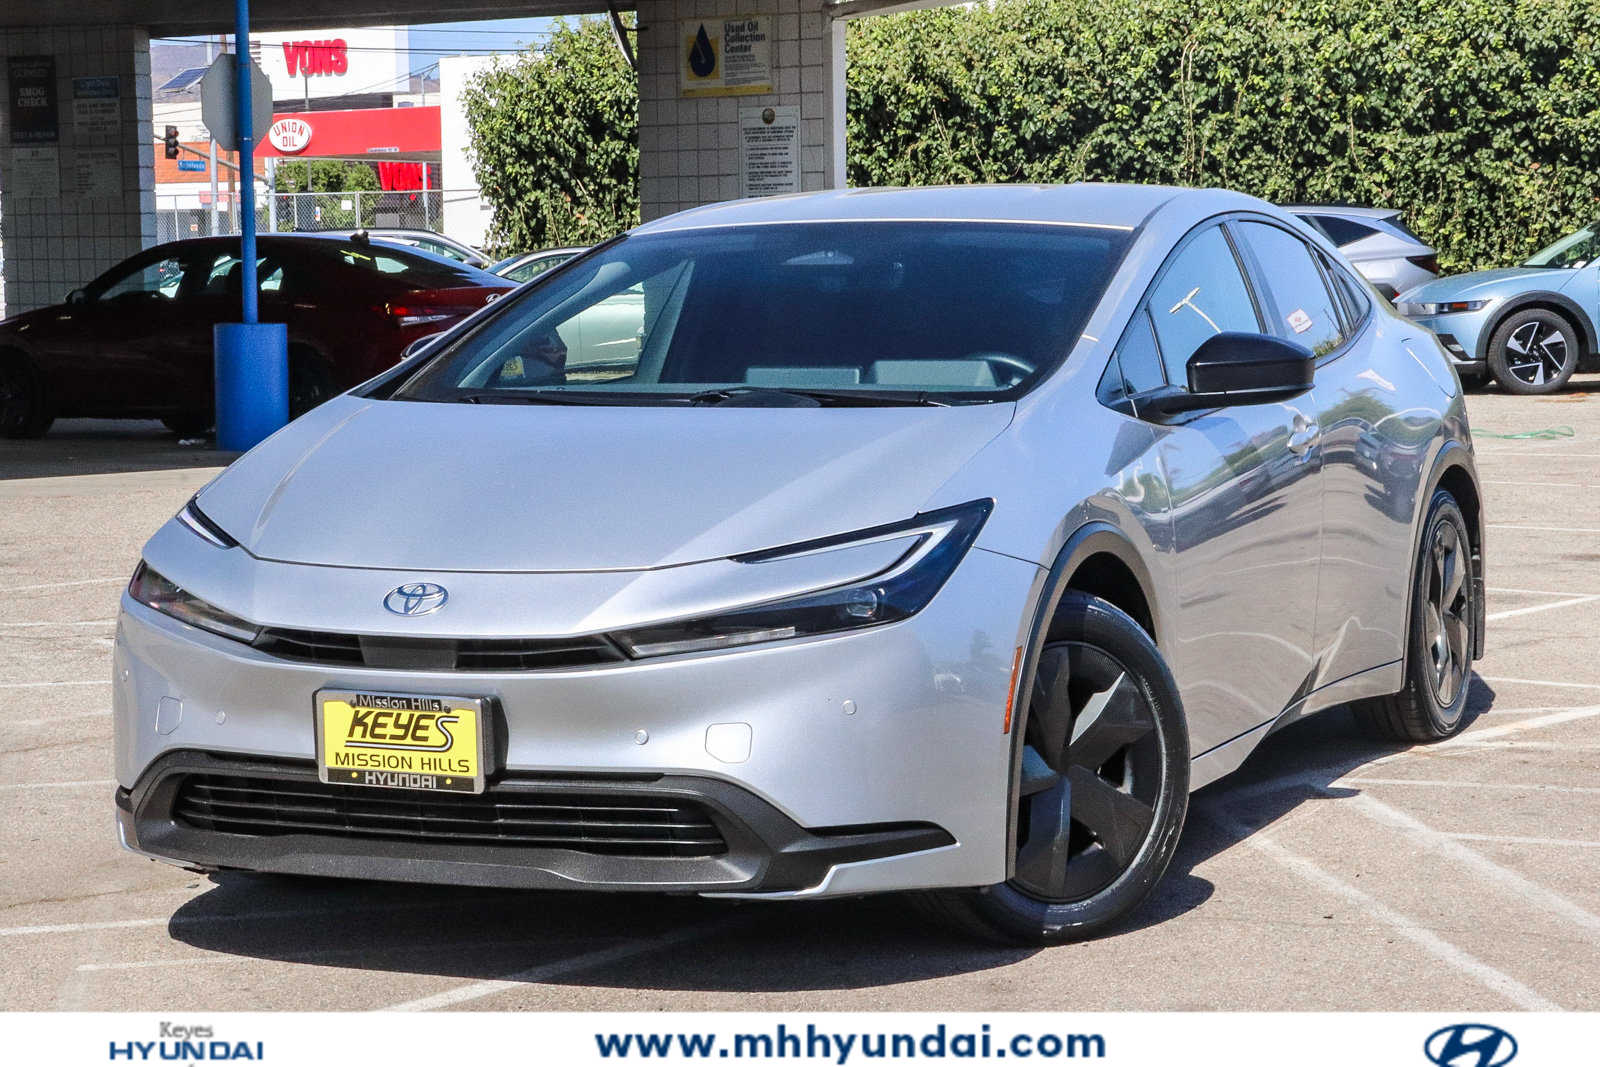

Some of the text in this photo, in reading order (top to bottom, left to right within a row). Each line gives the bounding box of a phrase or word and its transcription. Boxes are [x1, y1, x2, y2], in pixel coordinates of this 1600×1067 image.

[724, 20, 760, 34] Used Oil
[724, 32, 766, 43] Collection
[724, 44, 752, 54] Center
[282, 38, 348, 77] VONS
[18, 87, 46, 97] SMOG
[17, 96, 49, 106] CHECK
[272, 121, 305, 137] UNION
[282, 136, 298, 148] OIL
[359, 695, 440, 711] Mission Hills
[345, 710, 460, 751] KEYES
[335, 752, 470, 773] MISSION HILLS
[365, 771, 437, 788] HYUNDAI
